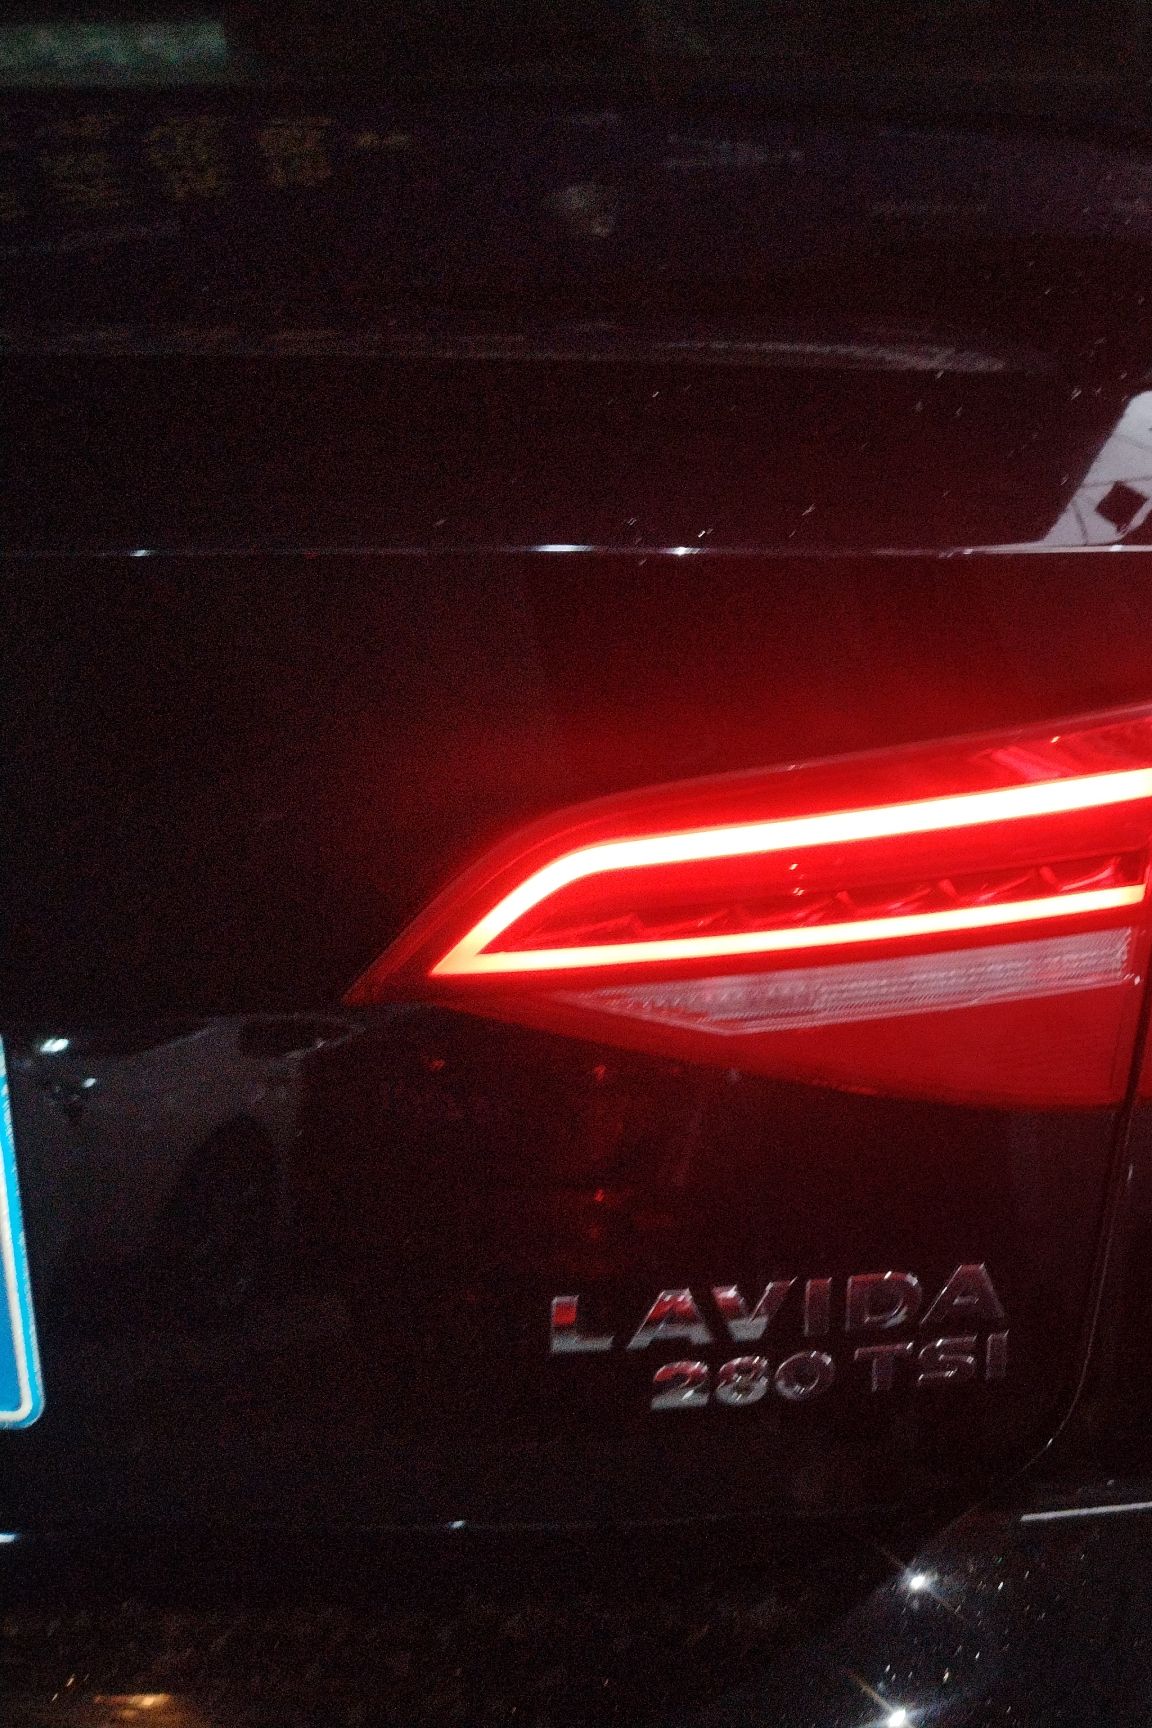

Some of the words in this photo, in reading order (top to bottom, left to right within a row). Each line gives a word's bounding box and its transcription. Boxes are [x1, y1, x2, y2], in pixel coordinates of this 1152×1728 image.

[550, 1262, 1006, 1353] LAVIDA
[651, 1350, 836, 1411] 280
[853, 1330, 1009, 1393] TSI
